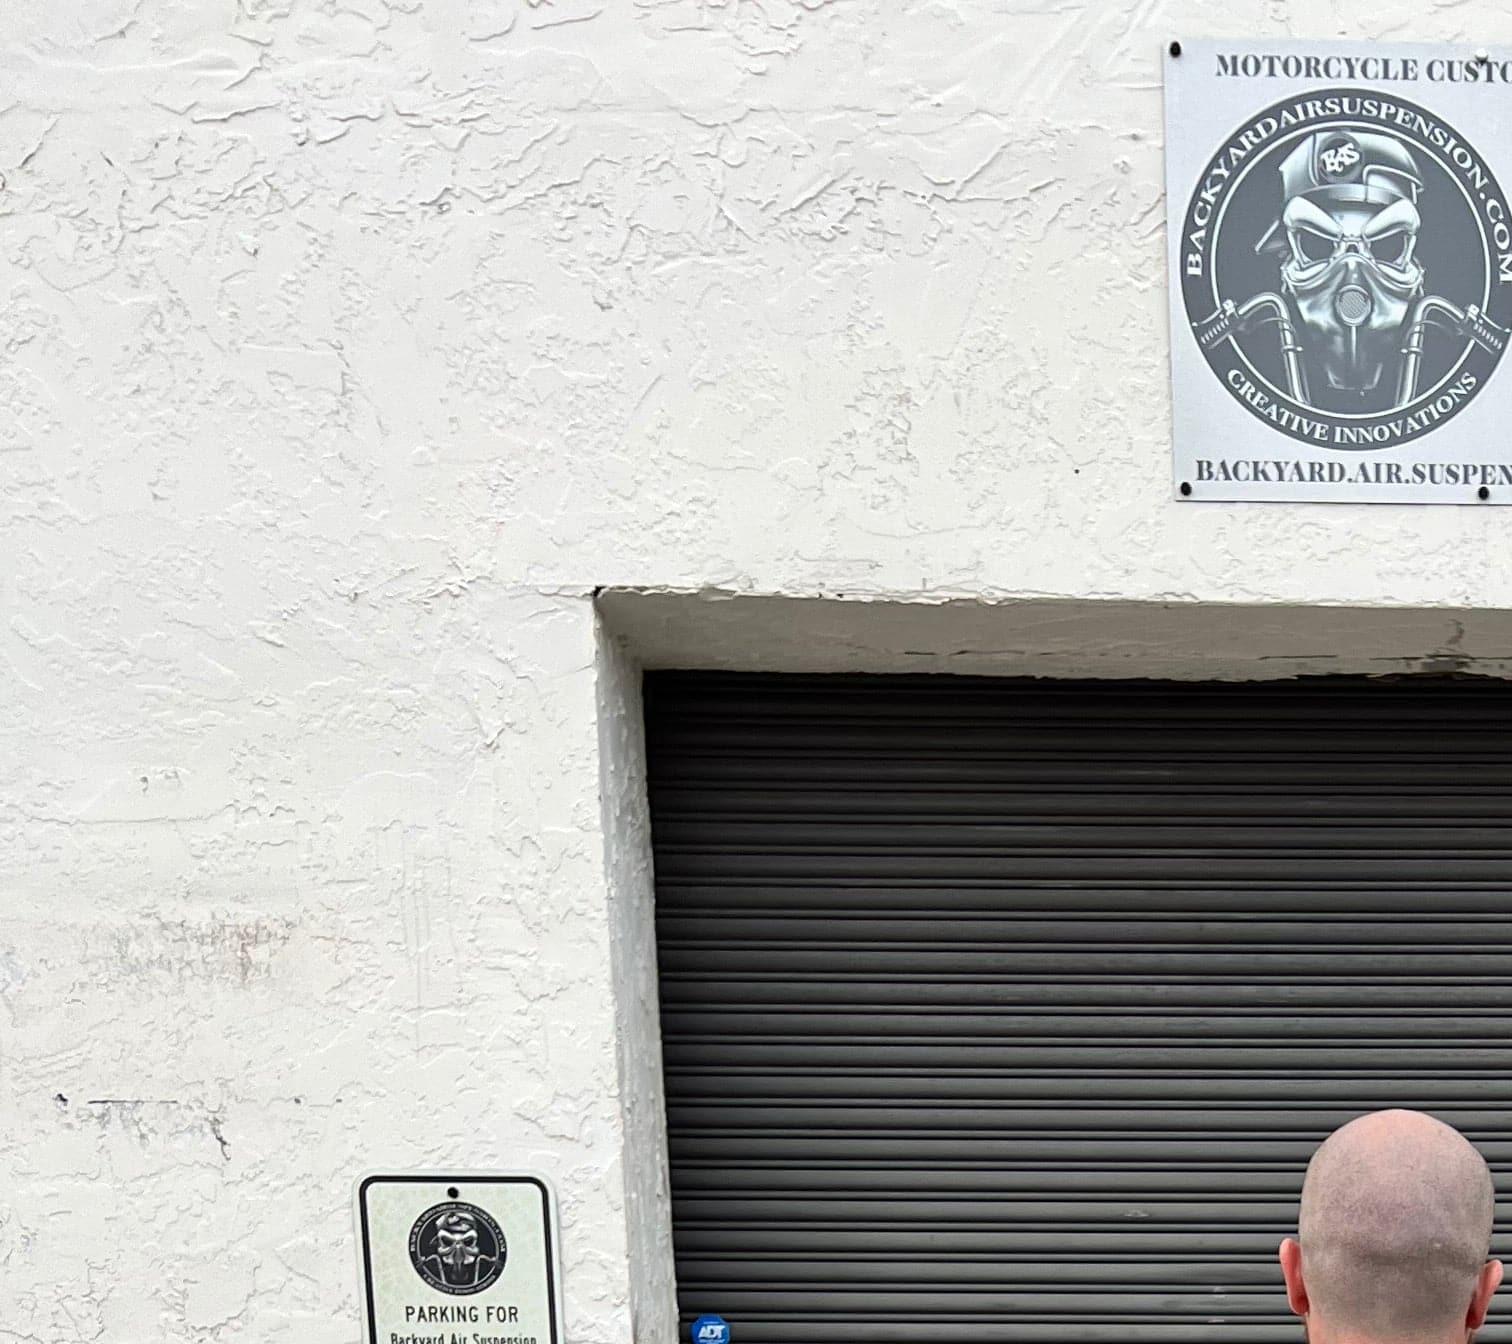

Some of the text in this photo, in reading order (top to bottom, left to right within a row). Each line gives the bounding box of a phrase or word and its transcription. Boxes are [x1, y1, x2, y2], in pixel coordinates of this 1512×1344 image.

[1215, 54, 1419, 83] MOTORCYCLE
[1227, 368, 1478, 446] CREATIVE INNOVATIONS
[405, 1305, 519, 1324] PARKING FOR
[698, 1325, 726, 1338] ADT
